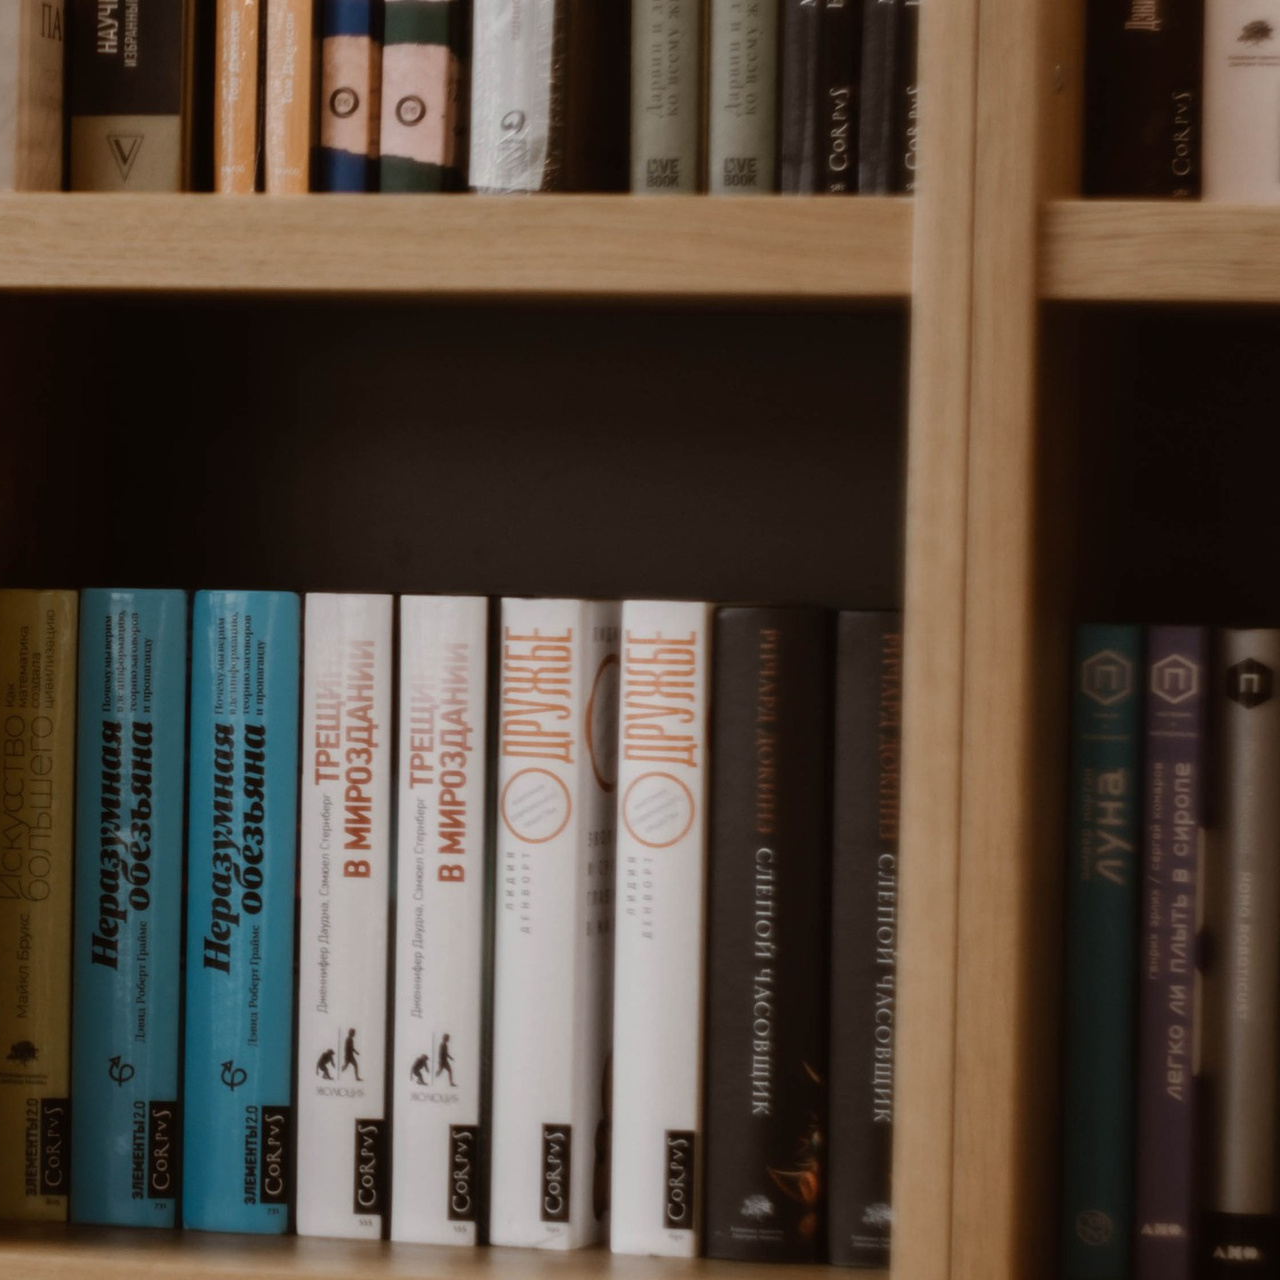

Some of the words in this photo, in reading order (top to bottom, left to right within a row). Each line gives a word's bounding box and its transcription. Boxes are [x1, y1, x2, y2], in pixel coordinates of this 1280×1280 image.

[281, 12, 297, 74] Джексон
[668, 28, 684, 86] всему
[746, 27, 762, 84] всему
[42, 610, 57, 709] цивилизацию
[105, 616, 114, 650] верим
[130, 612, 140, 670] заговоров
[218, 618, 226, 652] верим
[244, 615, 254, 671] заговоров
[5, 683, 16, 708] Как
[18, 625, 30, 709] математика
[30, 652, 42, 709] создала
[102, 670, 114, 712] Почему
[130, 671, 140, 712] теорию
[144, 638, 154, 702] пропаганду
[214, 672, 226, 715] Почему
[242, 674, 253, 714] теорию
[256, 640, 266, 705] пропаганду
[501, 626, 575, 764] ДРУЖБЕ
[624, 630, 698, 768] ДРУЖБЕ
[344, 640, 378, 850] МИРОЗДАНИИ
[438, 644, 473, 854] МИРОЗДАНИИ
[24, 714, 54, 902] большего
[120, 722, 153, 912] обезьяна
[234, 724, 266, 915] обезьяна
[1152, 762, 1164, 820] комаров
[1172, 762, 1196, 856] сиропе
[90, 720, 128, 972] Неразумная
[203, 723, 240, 975] Неразумная
[320, 794, 334, 850] Стернберг
[413, 798, 427, 854] Стернберг
[1149, 825, 1164, 872] сергей
[318, 853, 332, 897] Сэмюел
[344, 860, 372, 878] В
[413, 858, 426, 901] Сэмюел
[438, 864, 466, 882] В
[505, 852, 516, 910] ЛИДИЯ
[520, 852, 532, 935] ДЕНВОРТ
[626, 856, 638, 915] ЛИДИЯ
[1172, 868, 1188, 884] в
[318, 899, 332, 945] Даудна,
[412, 904, 426, 949] Даудна,
[642, 856, 654, 940] ДЕНВОРТ
[754, 846, 779, 958] СЛЕПОЙ
[1148, 890, 1162, 928] эрлих
[14, 913, 32, 962] Брукс
[135, 921, 149, 961] Граймс
[248, 925, 262, 965] Граймс
[1148, 934, 1162, 980] генрих
[1168, 894, 1188, 974] плыть
[14, 966, 30, 1019] Майкл
[135, 963, 148, 1004] Роберт
[248, 968, 262, 1008] Роберт
[316, 947, 330, 1014] Дженнифер
[410, 952, 424, 1018] Дженнифер
[135, 1006, 148, 1044] Дэвид
[248, 1011, 261, 1048] Дэвид
[749, 968, 774, 1116] ЧАСОВЩИК
[872, 974, 894, 1123] ЧАСОВЩИК
[1166, 1026, 1185, 1102] легко
[133, 1101, 146, 1118] 2.0
[246, 1106, 258, 1123] 2.0
[25, 1118, 38, 1196] ЭЛЕМЕНТЫ
[132, 1122, 145, 1200] ЭЛЕМЕНТЫ
[244, 1126, 258, 1205] ЭЛЕМЕНТЫ
